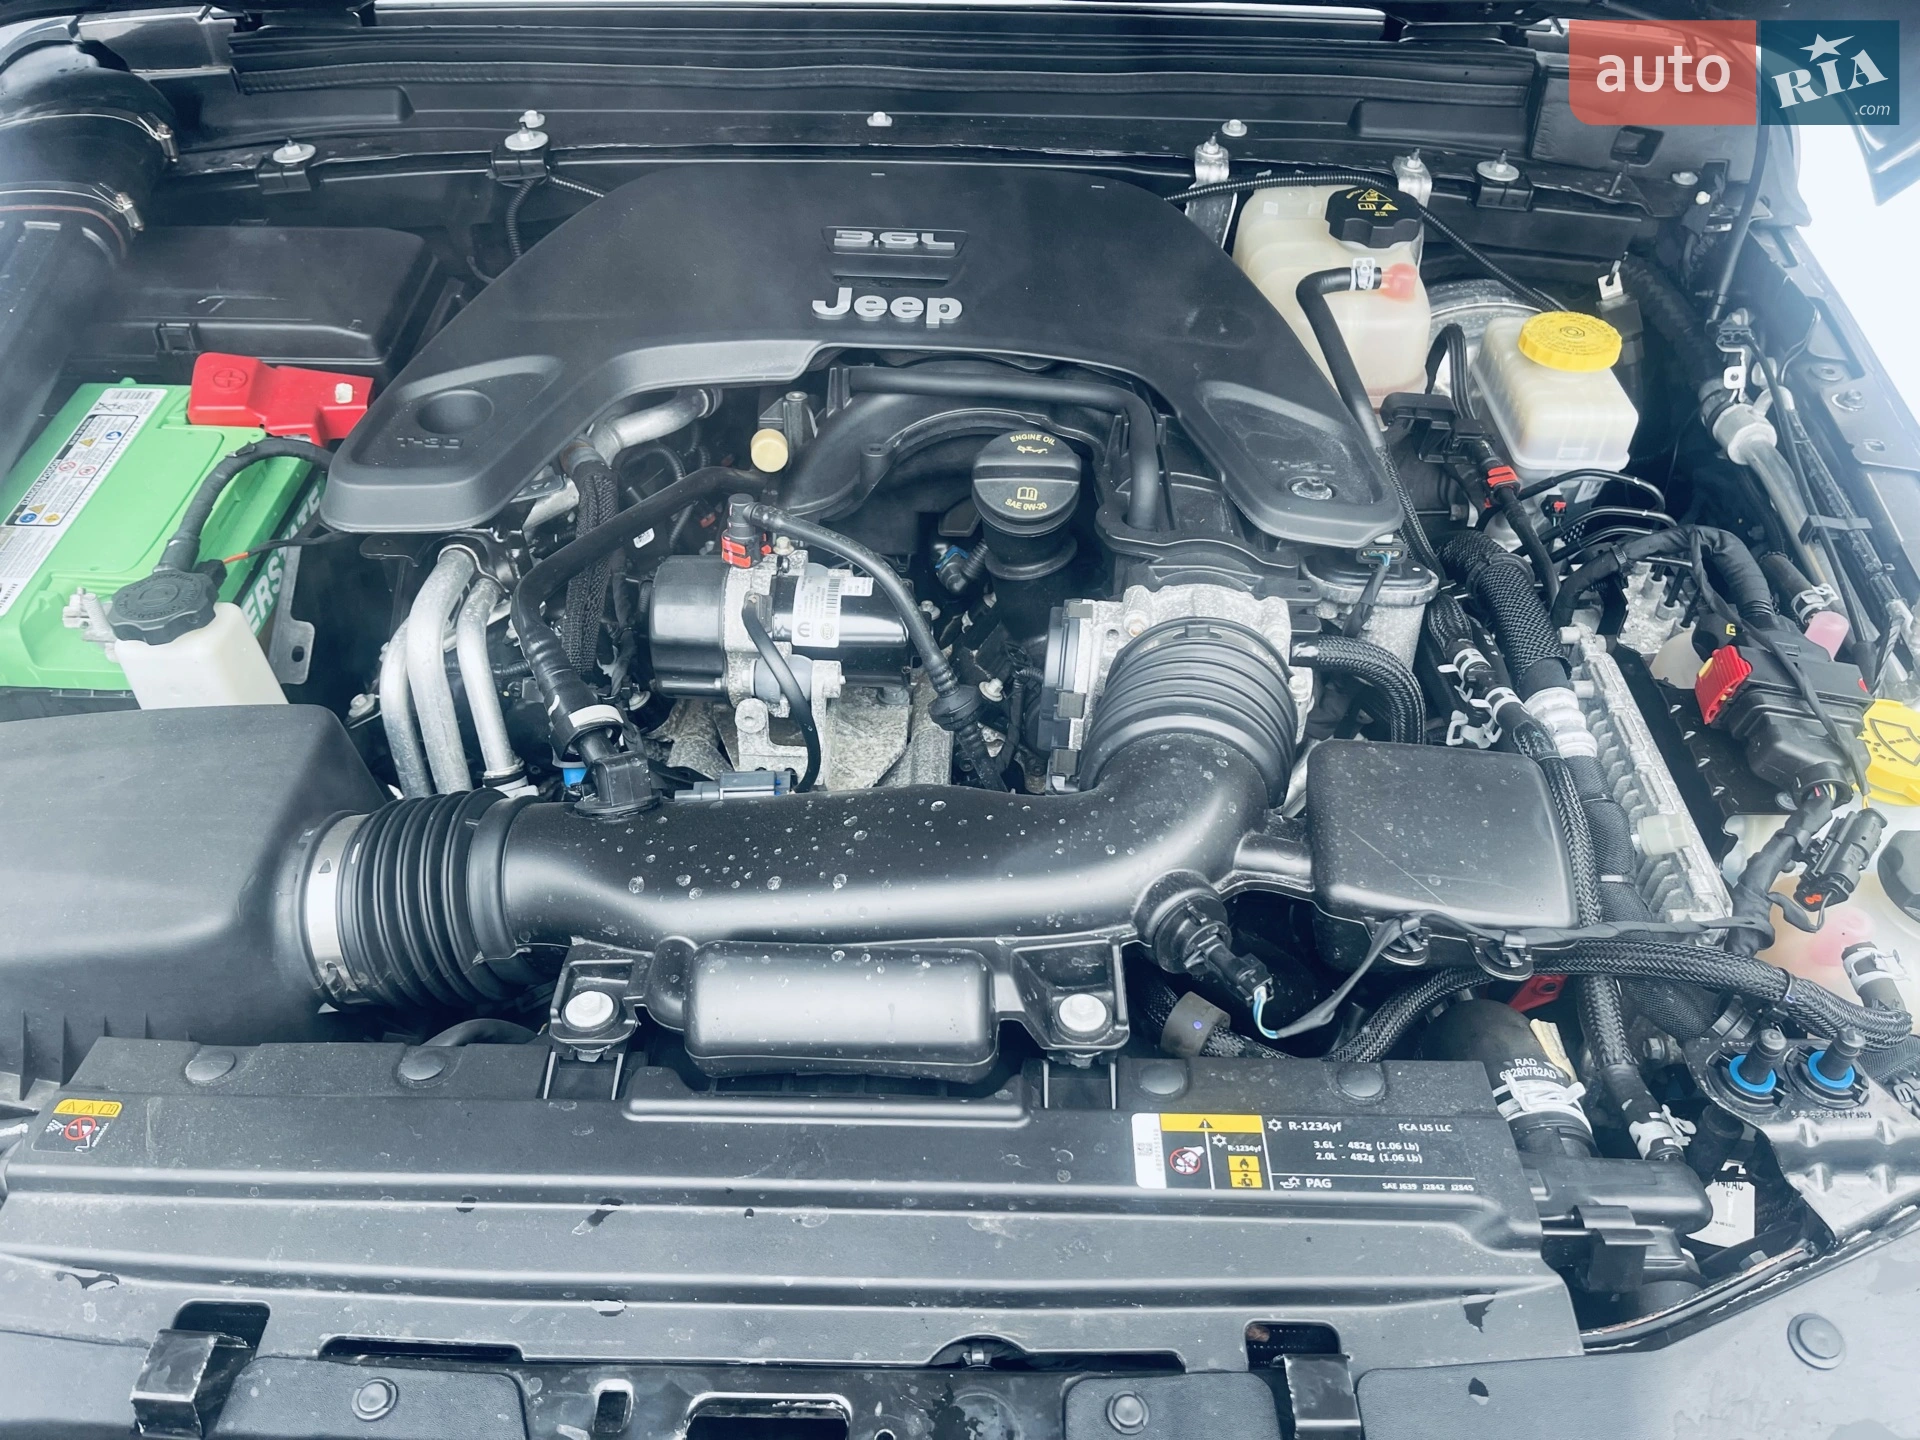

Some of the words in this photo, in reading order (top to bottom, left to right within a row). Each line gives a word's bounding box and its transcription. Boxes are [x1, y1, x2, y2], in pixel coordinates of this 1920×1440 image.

[834, 230, 955, 250] 3.6L
[812, 287, 963, 328] Jeep
[1009, 433, 1042, 443] ENGINE
[1042, 436, 1056, 446] OIL
[1005, 498, 1022, 509] SAE
[1022, 501, 1048, 511] 0W-20
[1514, 1058, 1538, 1067] RAD
[1288, 1121, 1342, 1133] R-1234yf
[1398, 1123, 1419, 1132] FCA
[1419, 1124, 1433, 1132] US
[1435, 1124, 1453, 1133] LLC
[1227, 1144, 1262, 1153] R-1234yf
[1313, 1140, 1335, 1149] 3.6L
[1347, 1141, 1373, 1151] 482g
[1376, 1142, 1402, 1151] (1.06
[1404, 1142, 1420, 1152] Lb)
[1315, 1152, 1337, 1161] 2.0L
[1349, 1153, 1375, 1163] 482g
[1379, 1154, 1405, 1163] (1.06
[1407, 1154, 1423, 1164] Lb)
[1305, 1178, 1333, 1189] PAG
[1381, 1182, 1398, 1190] SAE
[1422, 1184, 1446, 1192] J2842
